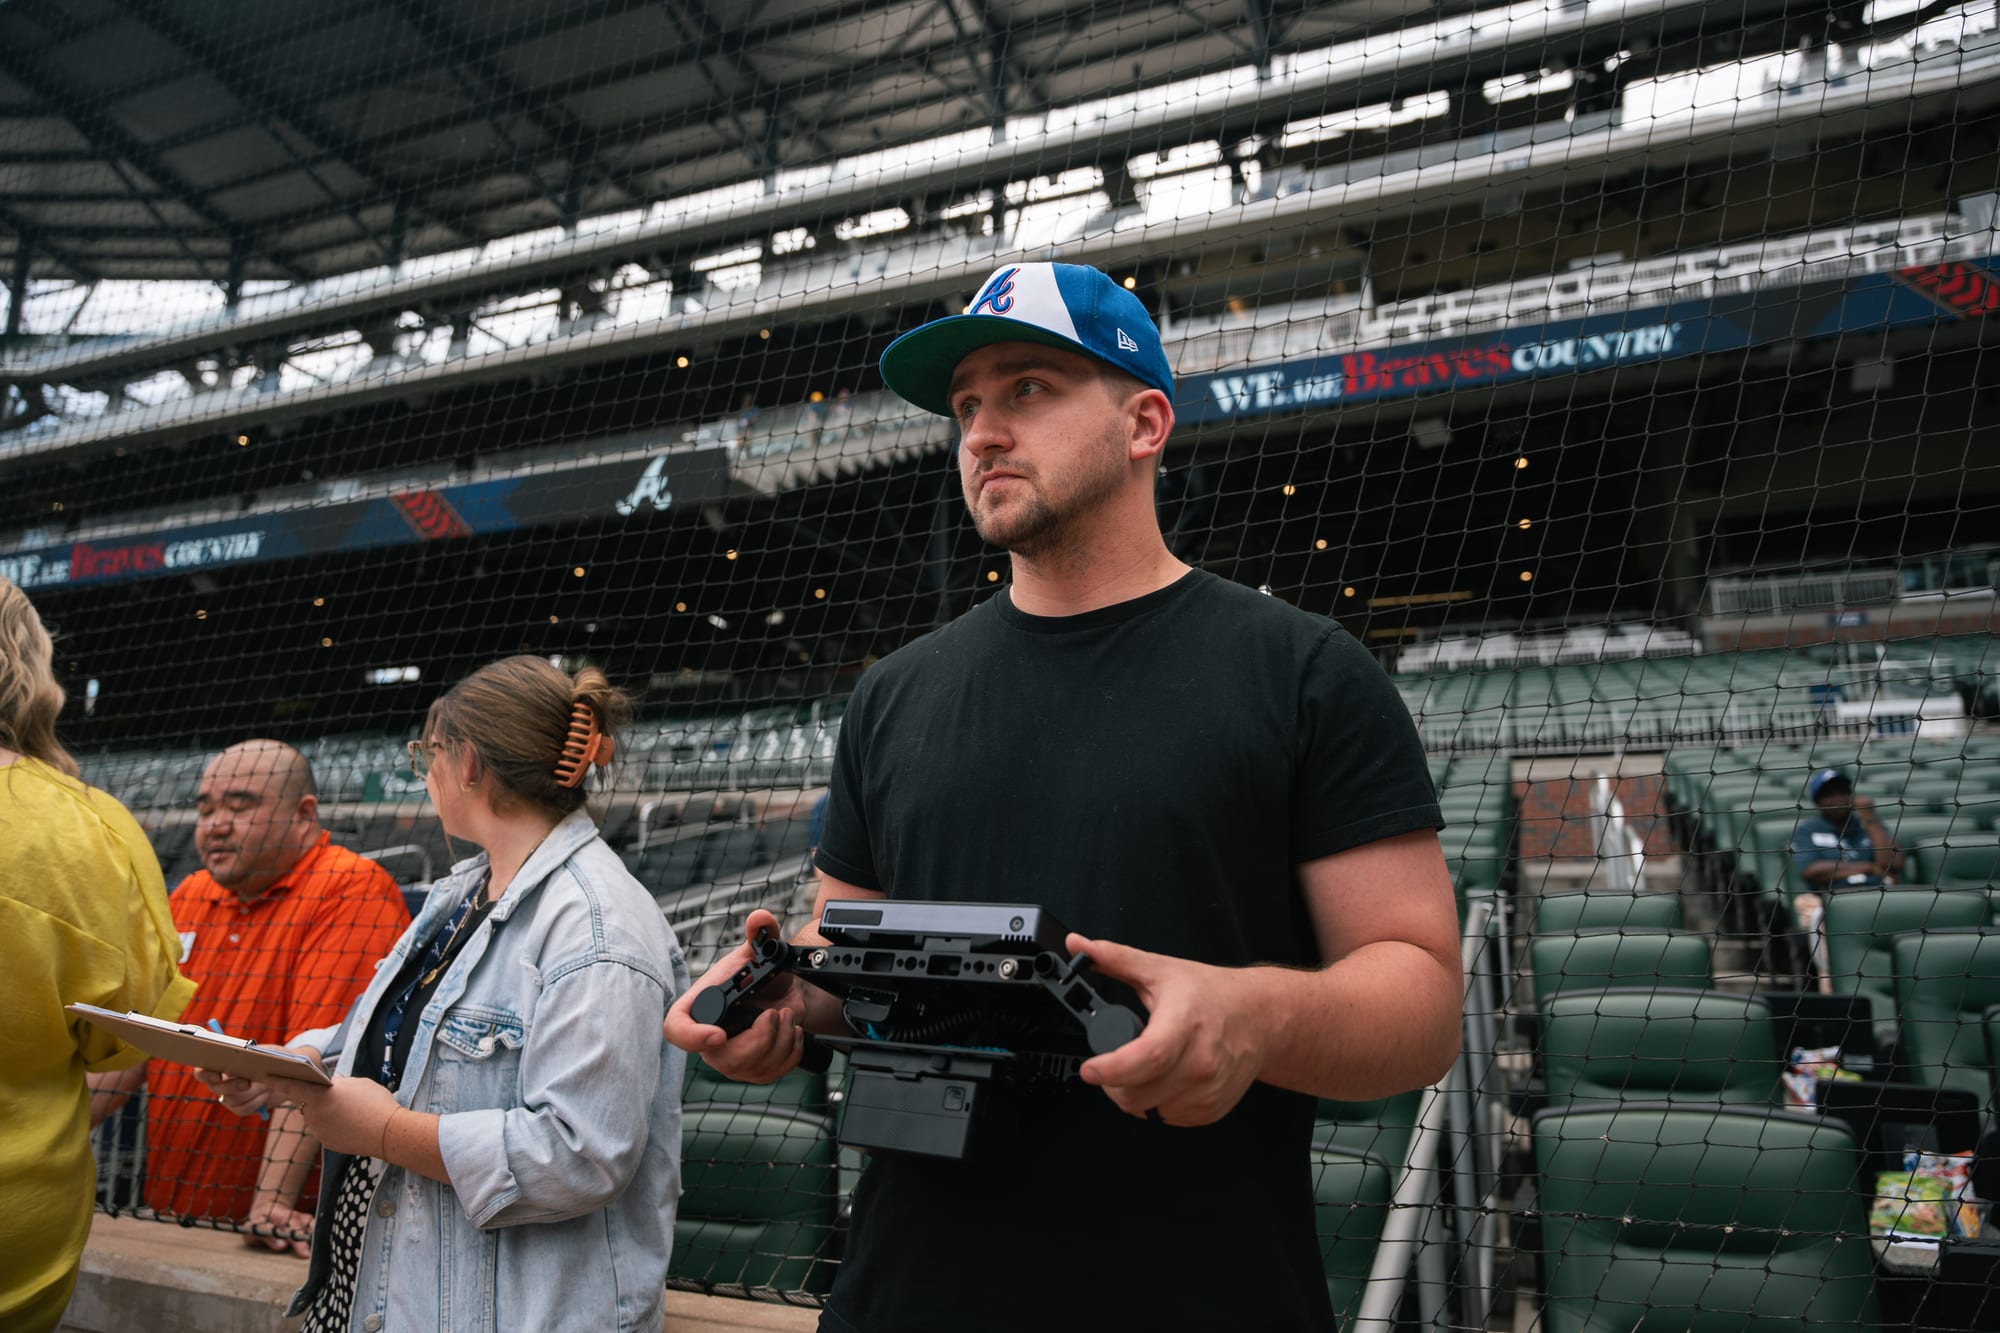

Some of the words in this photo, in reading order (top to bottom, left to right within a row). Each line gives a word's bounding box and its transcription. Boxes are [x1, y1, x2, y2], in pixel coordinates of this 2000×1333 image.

[970, 267, 1021, 315] A
[1210, 370, 1287, 414] WE
[1292, 372, 1343, 403] ARE
[1341, 343, 1511, 395] Braves
[1511, 322, 1683, 372] COUNTRY
[615, 455, 673, 516] A
[69, 541, 166, 581] Braves
[164, 530, 266, 569] COUNTRY
